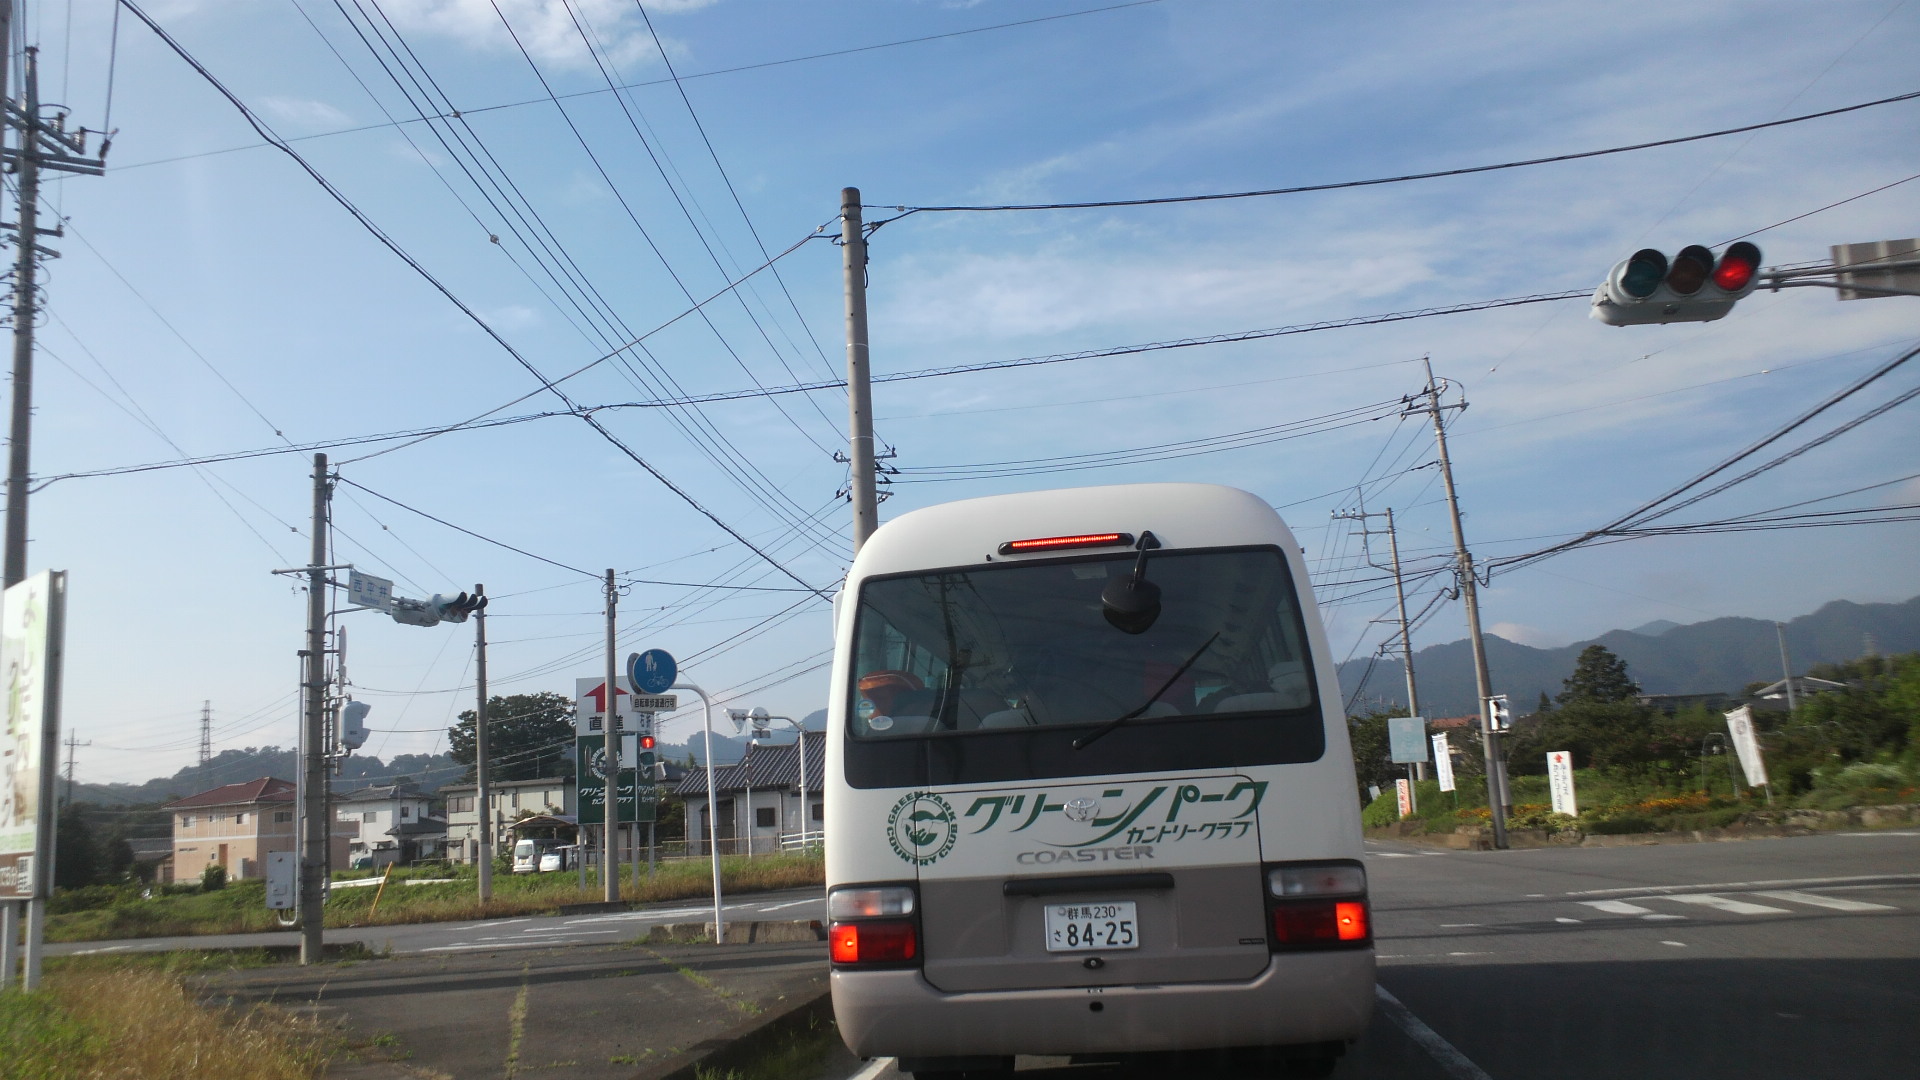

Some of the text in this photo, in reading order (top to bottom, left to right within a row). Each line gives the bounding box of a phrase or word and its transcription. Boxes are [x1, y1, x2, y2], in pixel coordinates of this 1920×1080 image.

[634, 698, 675, 708] 自転車歩道通行可
[887, 790, 924, 825] GREEN
[964, 780, 1270, 847] グリーンパーク
[887, 823, 958, 866] COUNTRY CLUB
[1126, 820, 1254, 845] カントリークラブ
[1016, 845, 1156, 866] COASTER
[1067, 920, 1133, 947] 84-25
